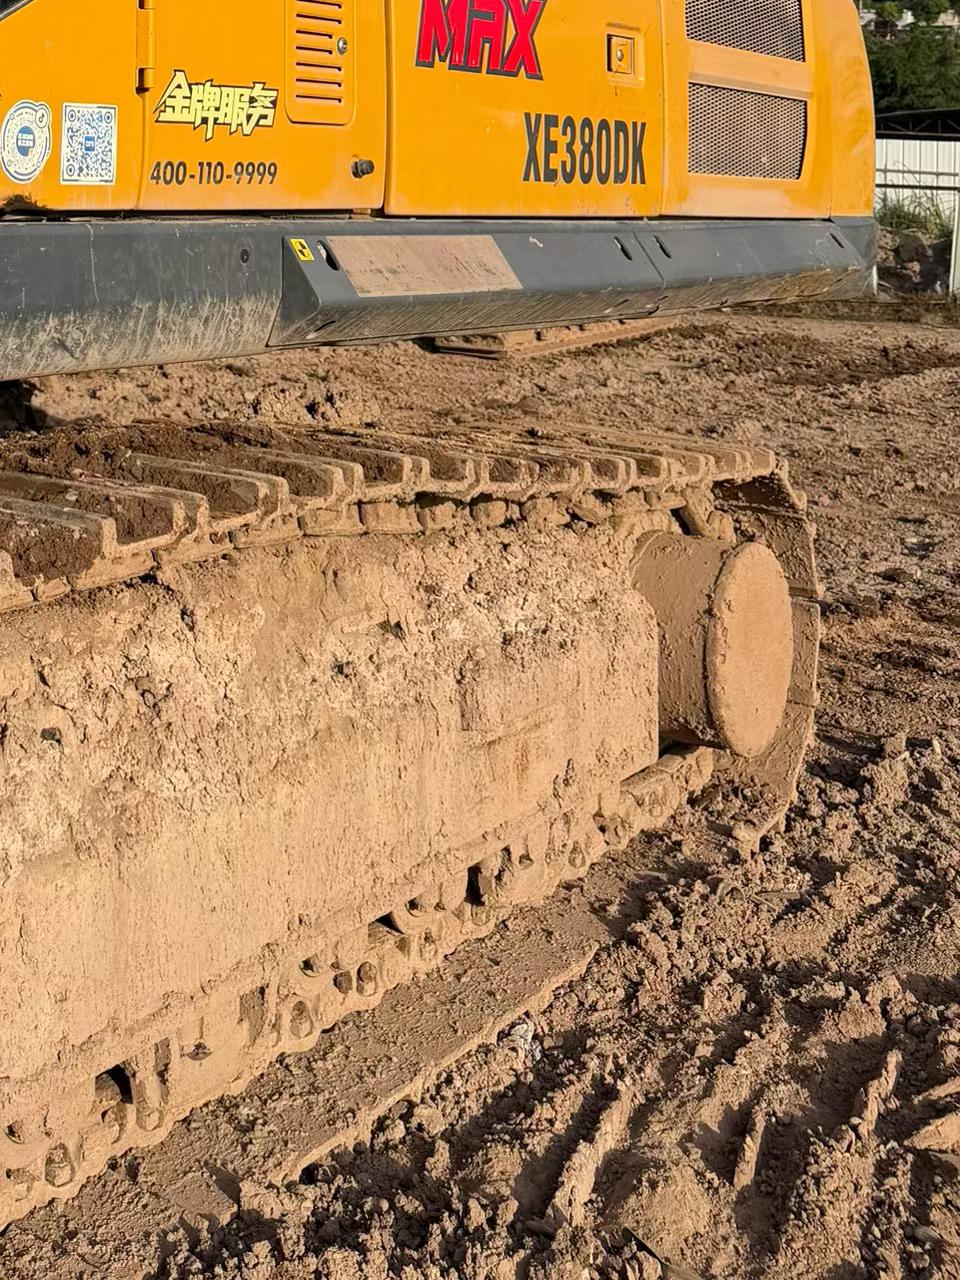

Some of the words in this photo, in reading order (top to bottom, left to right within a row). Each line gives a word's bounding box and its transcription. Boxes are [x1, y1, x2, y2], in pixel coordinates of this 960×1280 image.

[153, 69, 279, 141] 金牌服务
[150, 161, 277, 185] 400-110-9999
[523, 112, 646, 185] XE380DK
